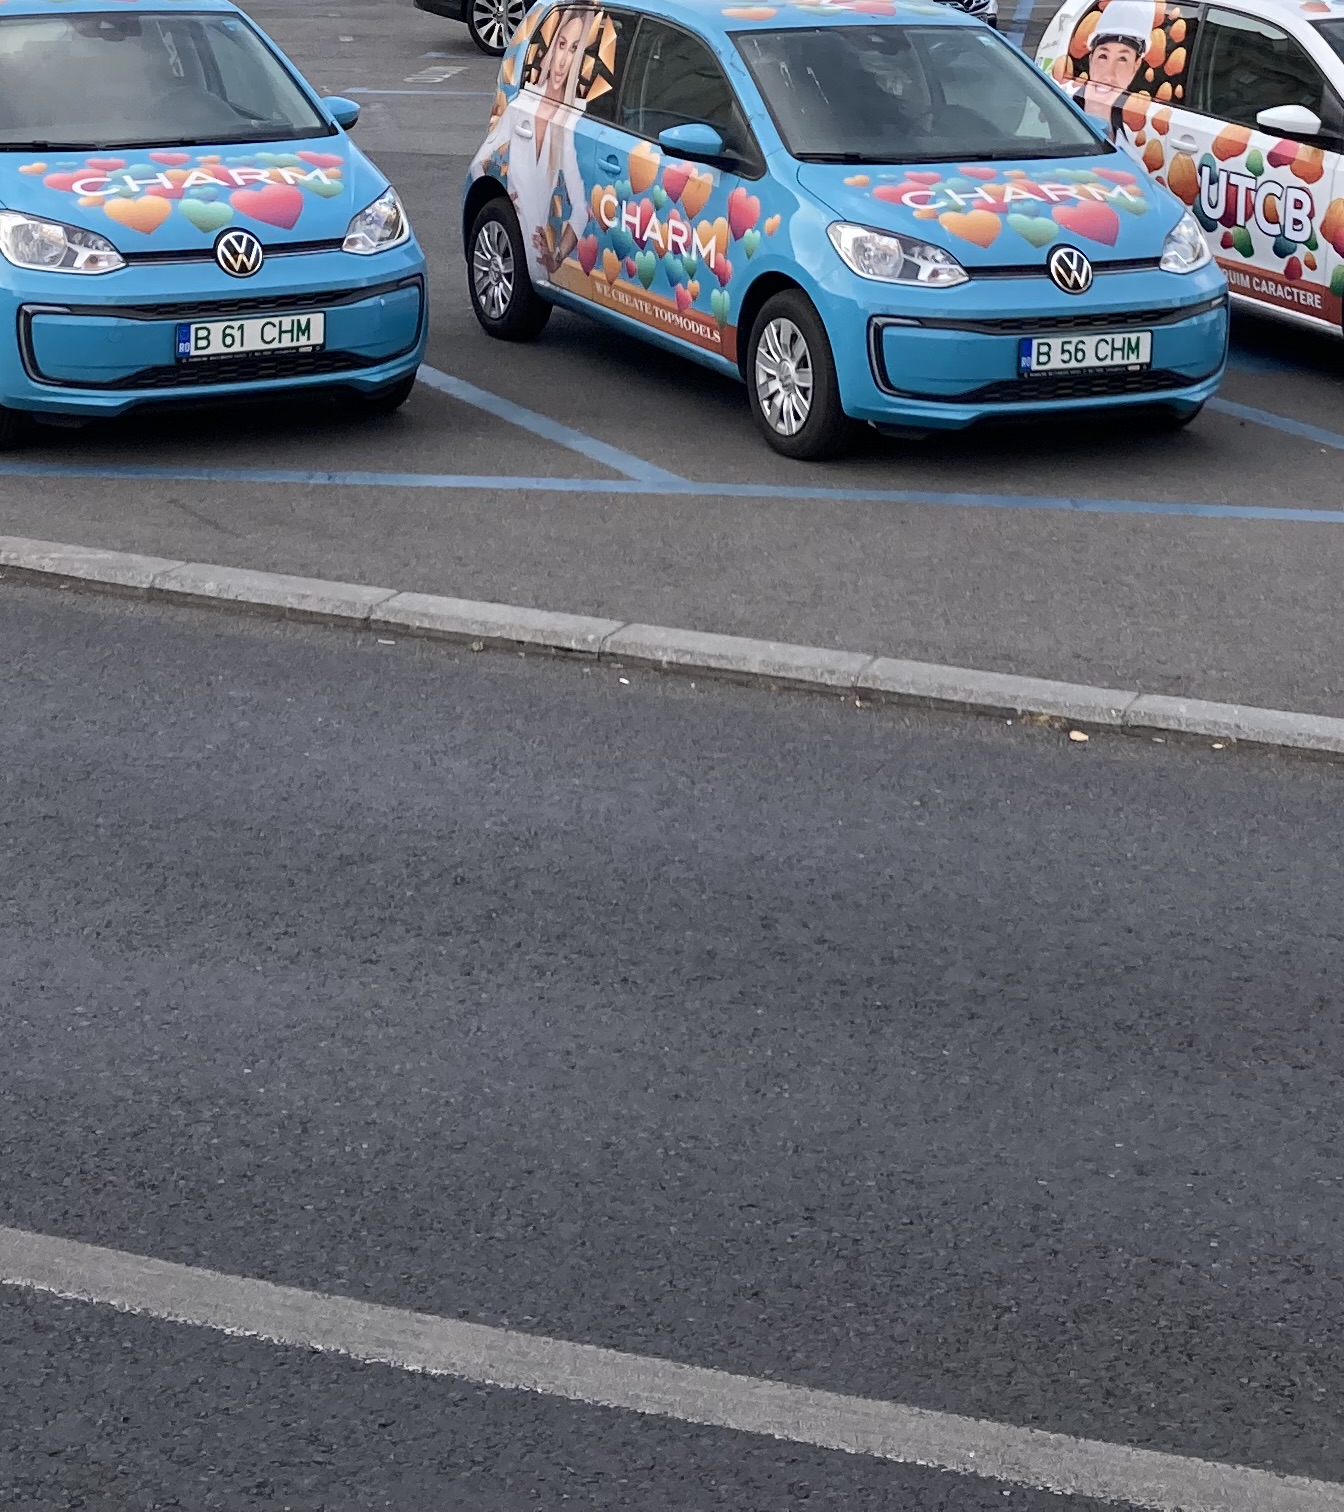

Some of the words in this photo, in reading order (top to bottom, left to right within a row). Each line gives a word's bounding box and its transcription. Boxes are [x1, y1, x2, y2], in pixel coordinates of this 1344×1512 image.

[72, 168, 332, 197] CHARM
[901, 184, 1137, 210] CHARM
[1200, 164, 1314, 243] UTCB
[600, 194, 717, 269] CHARM
[1253, 278, 1322, 308] CARACTERE
[595, 281, 612, 298] WE
[612, 287, 653, 316] CREATE
[653, 306, 721, 343] TOPMODELS
[194, 327, 211, 351] B
[222, 324, 244, 348] 61
[260, 318, 311, 345] CHM
[1036, 342, 1051, 366] B
[1061, 340, 1086, 364] 56
[1095, 336, 1140, 361] CHM
